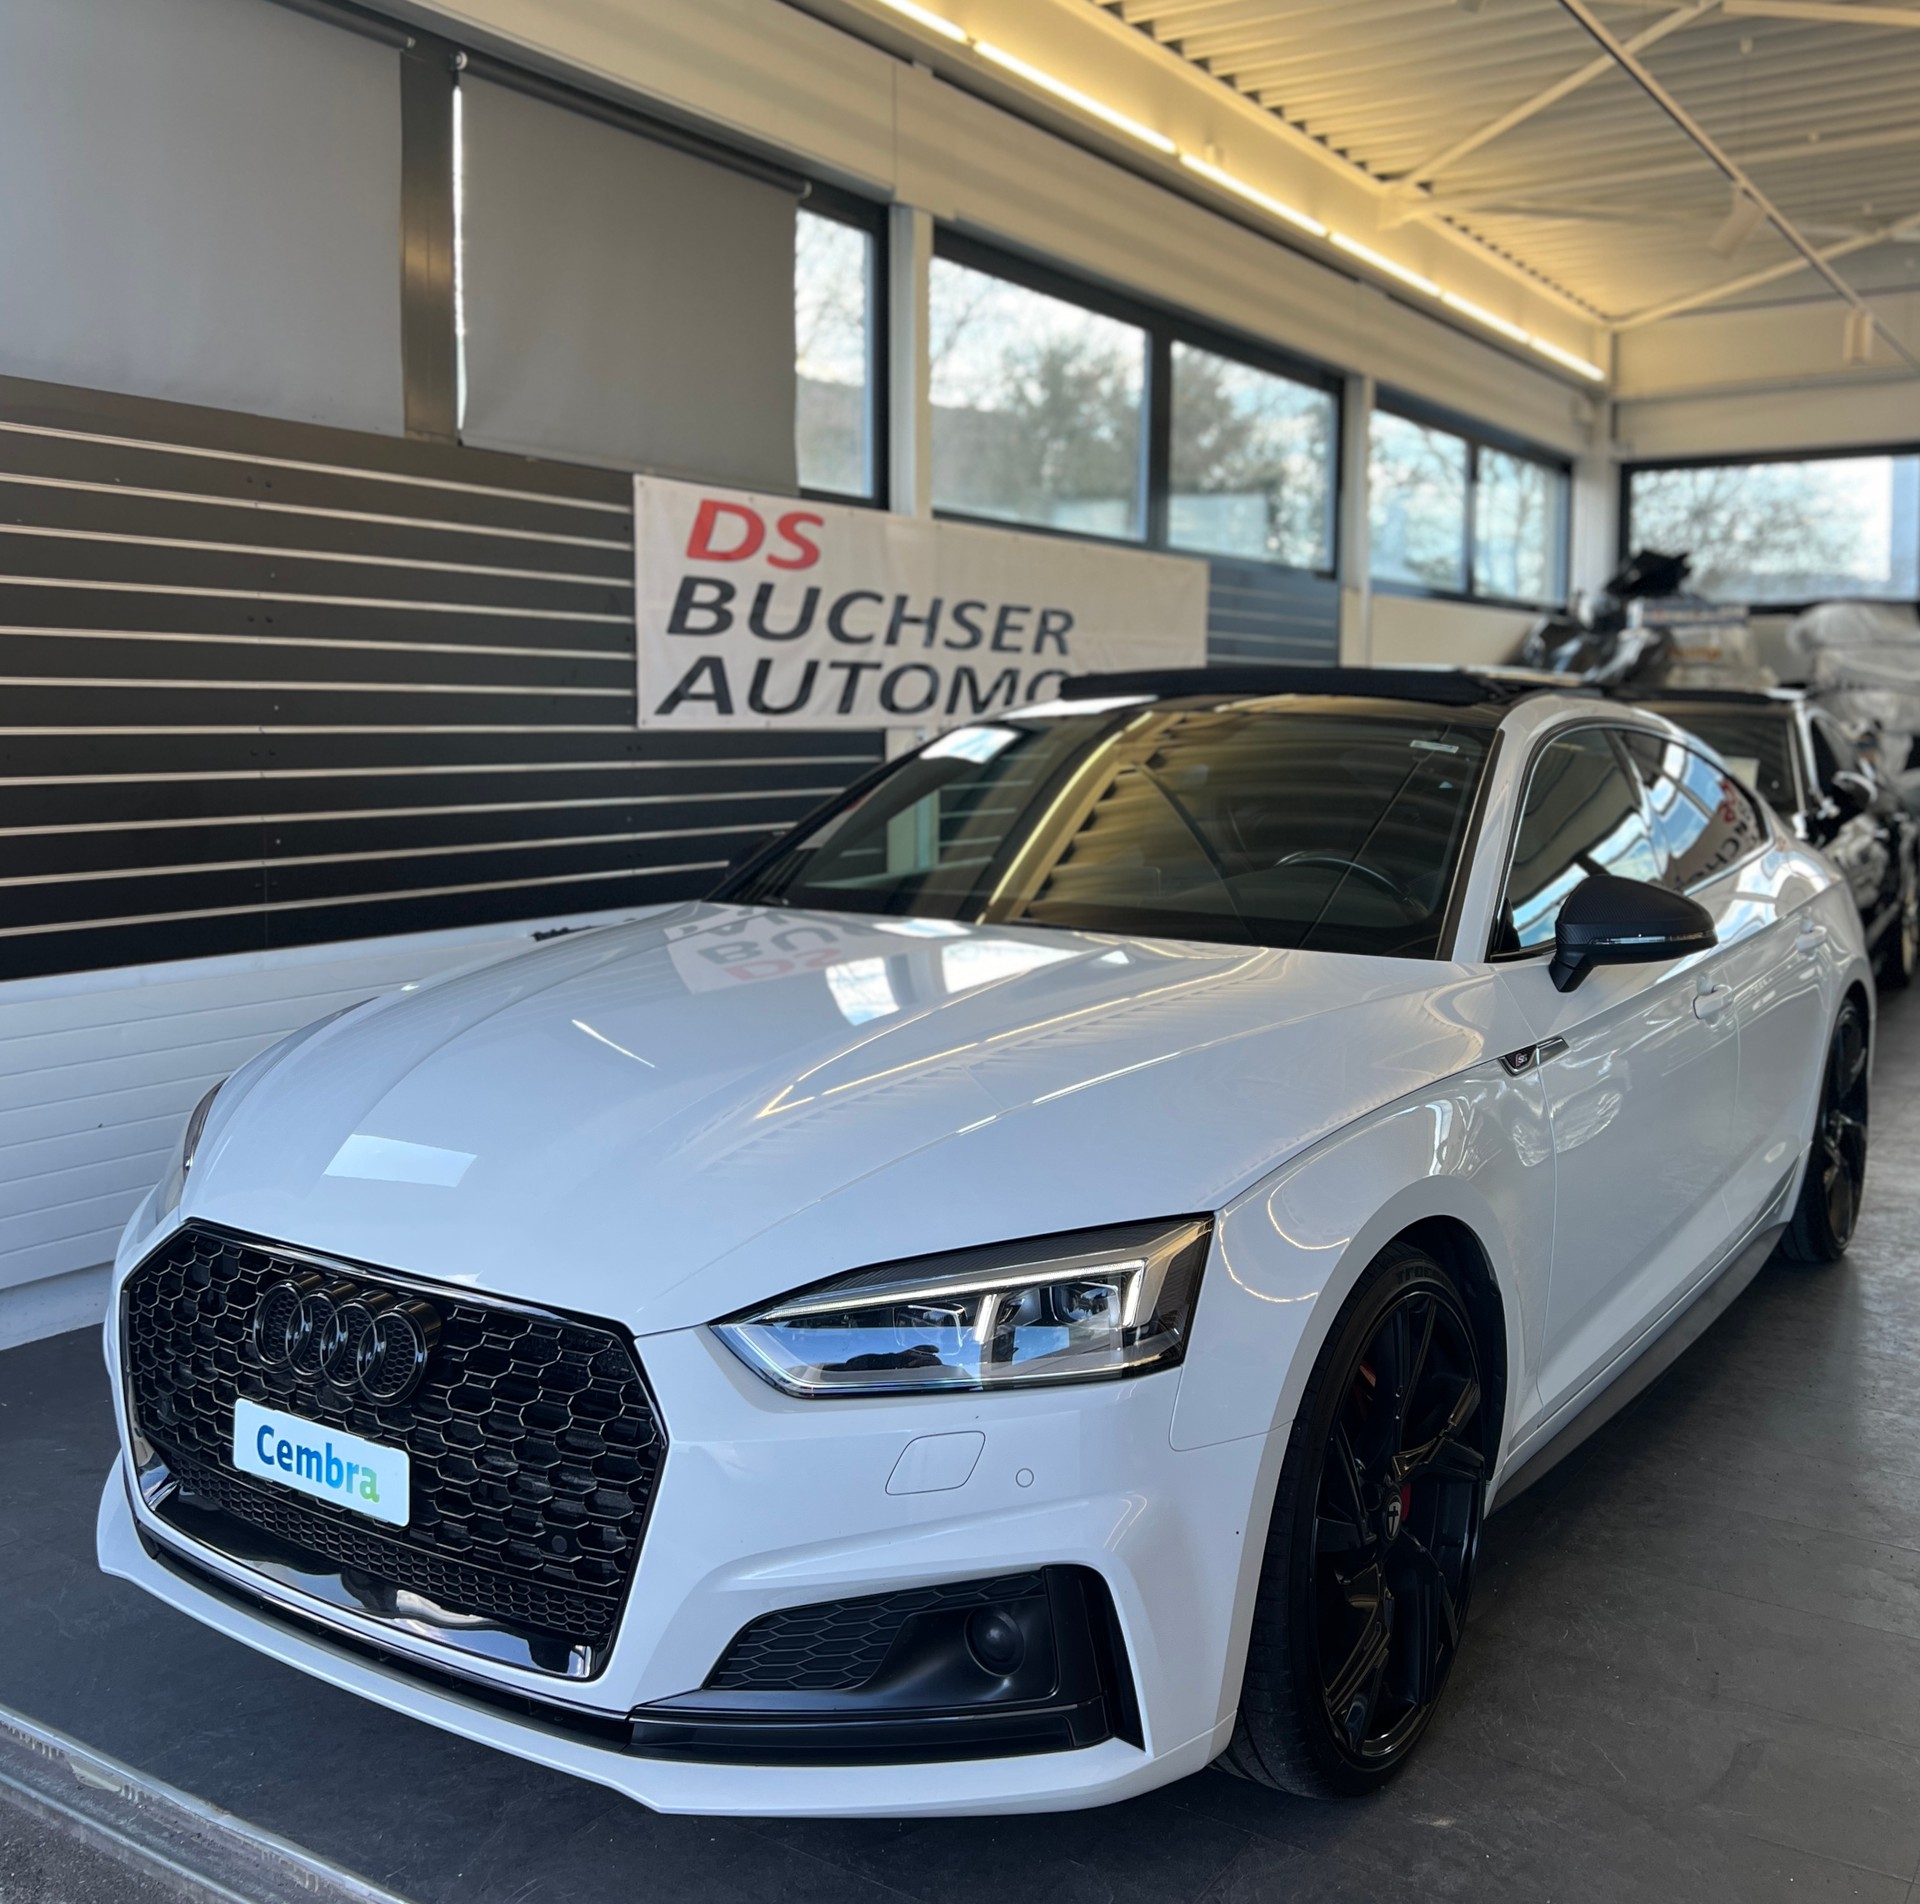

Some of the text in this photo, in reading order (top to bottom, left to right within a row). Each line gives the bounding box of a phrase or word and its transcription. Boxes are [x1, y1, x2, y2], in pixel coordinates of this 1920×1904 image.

[685, 498, 824, 570] DS
[666, 575, 1075, 656] BUCHSER
[256, 1424, 380, 1503] Cembra
